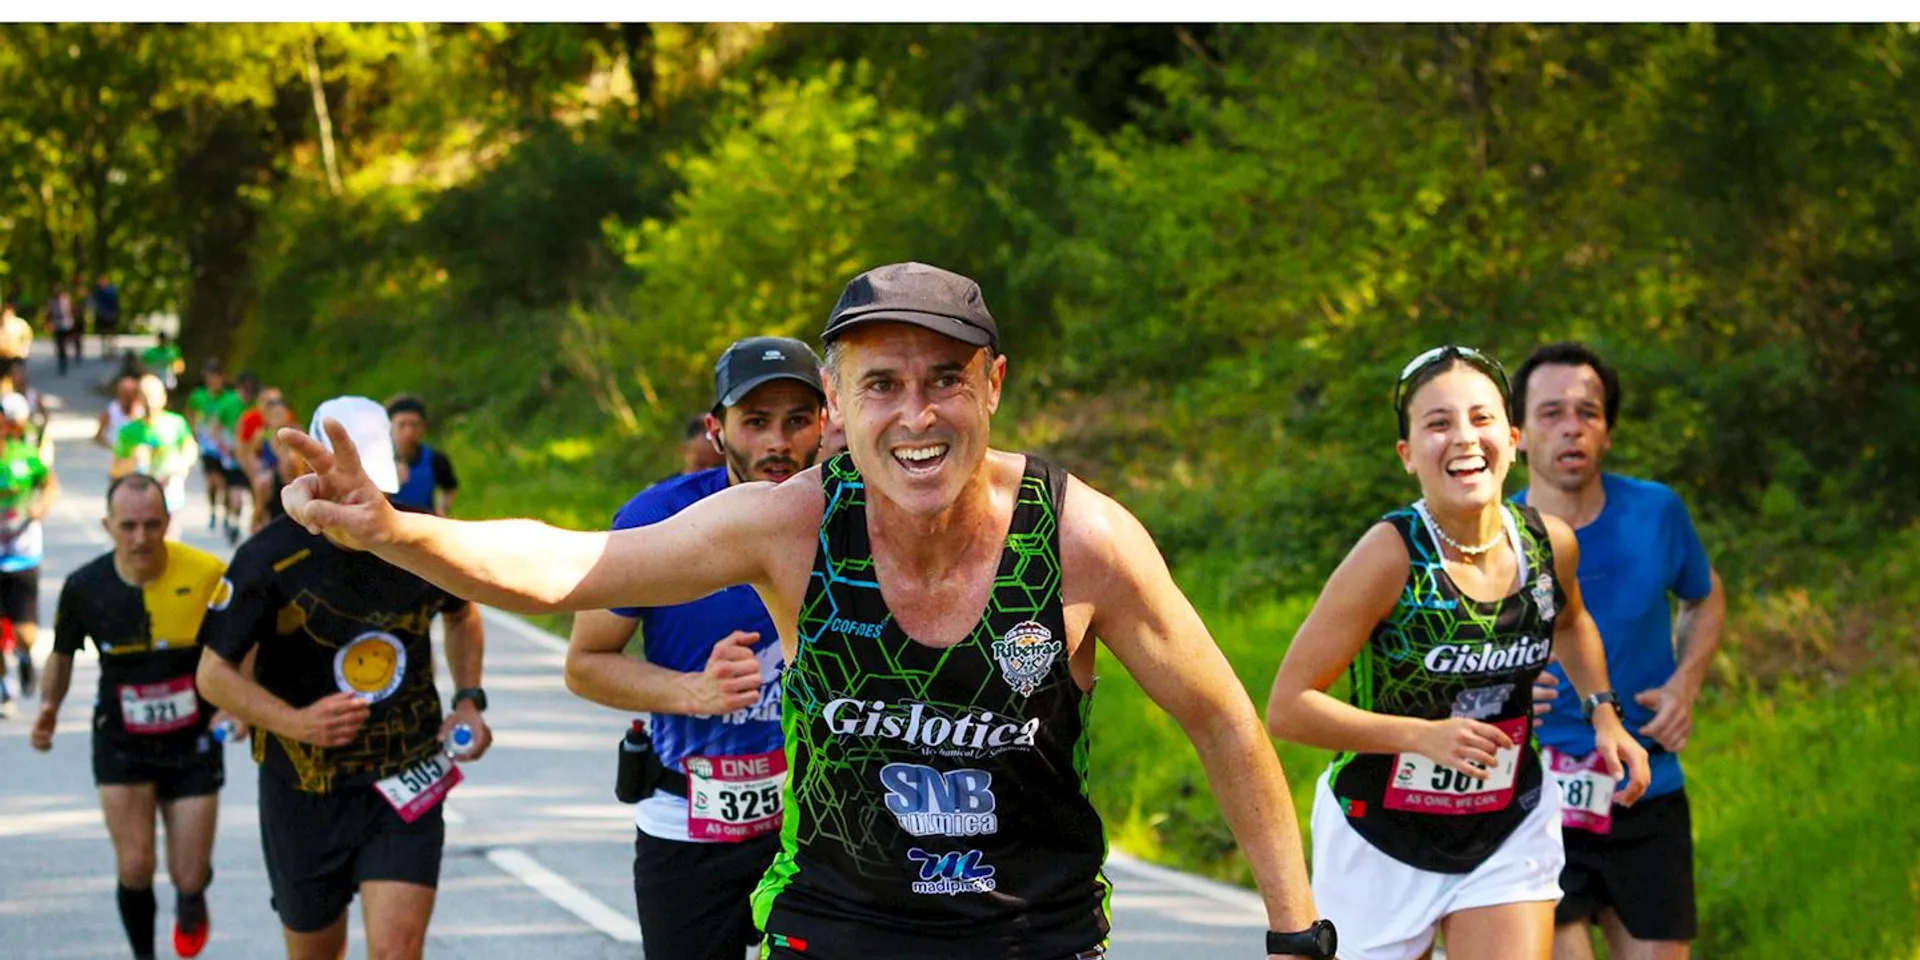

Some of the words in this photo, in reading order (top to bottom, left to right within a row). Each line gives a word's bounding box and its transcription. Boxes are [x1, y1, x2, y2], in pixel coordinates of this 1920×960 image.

[1424, 635, 1549, 673] Gislotica
[822, 698, 1040, 748] Gislotica
[720, 757, 770, 777] ONE
[718, 785, 780, 822] 325
[879, 762, 996, 813] SNB
[1557, 779, 1594, 808] 81
